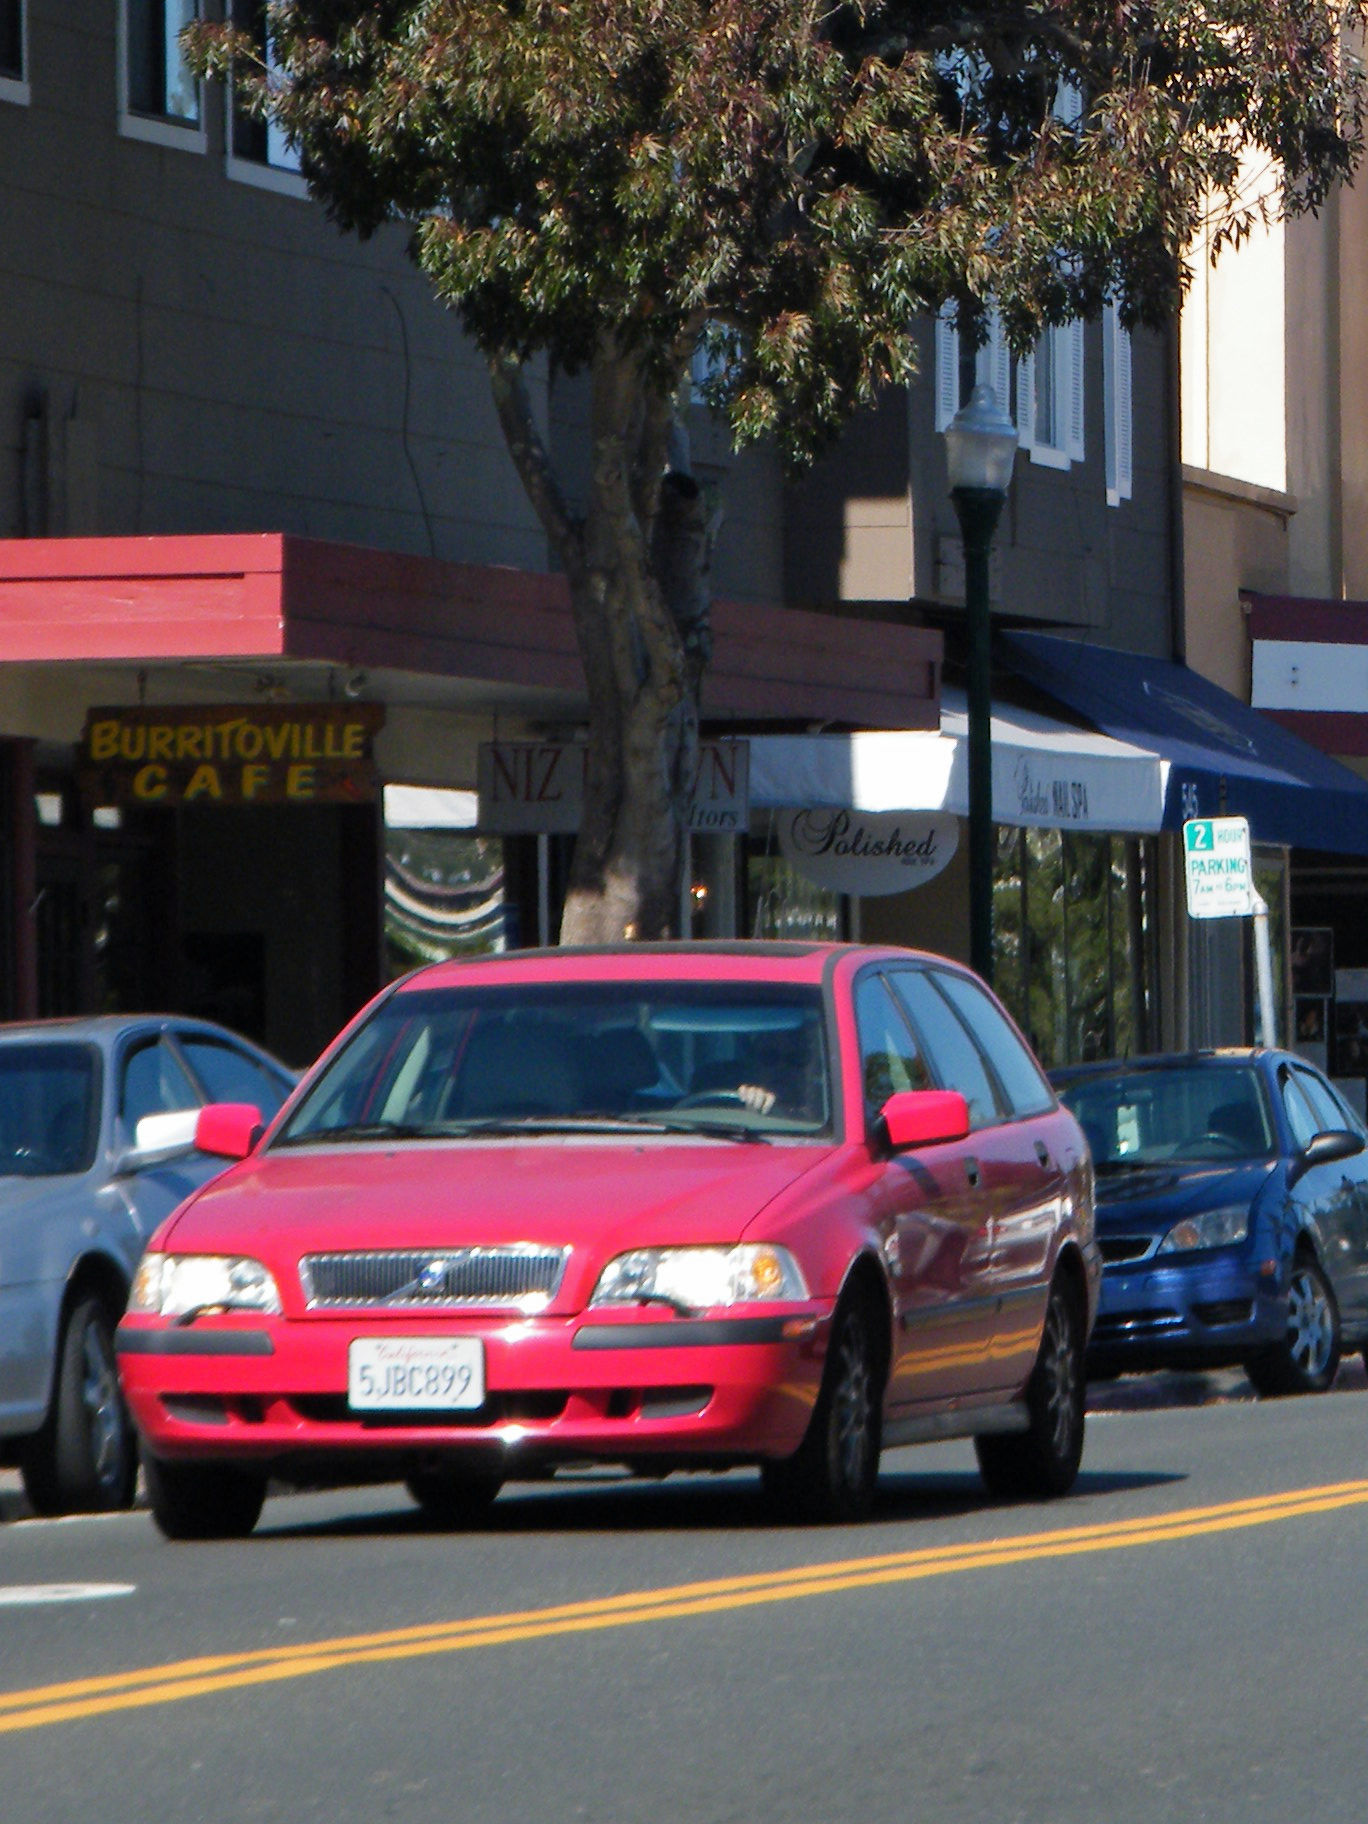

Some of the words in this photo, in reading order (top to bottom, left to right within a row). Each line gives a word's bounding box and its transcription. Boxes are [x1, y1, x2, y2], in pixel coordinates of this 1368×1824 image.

[91, 717, 364, 760] BURRITOVILLE
[133, 764, 317, 800] CAFE
[491, 746, 562, 802] NIZ
[791, 808, 937, 857] Polished
[1193, 823, 1207, 849] 2
[1190, 858, 1246, 876] PARKING
[359, 1364, 473, 1399] 5JBC899
